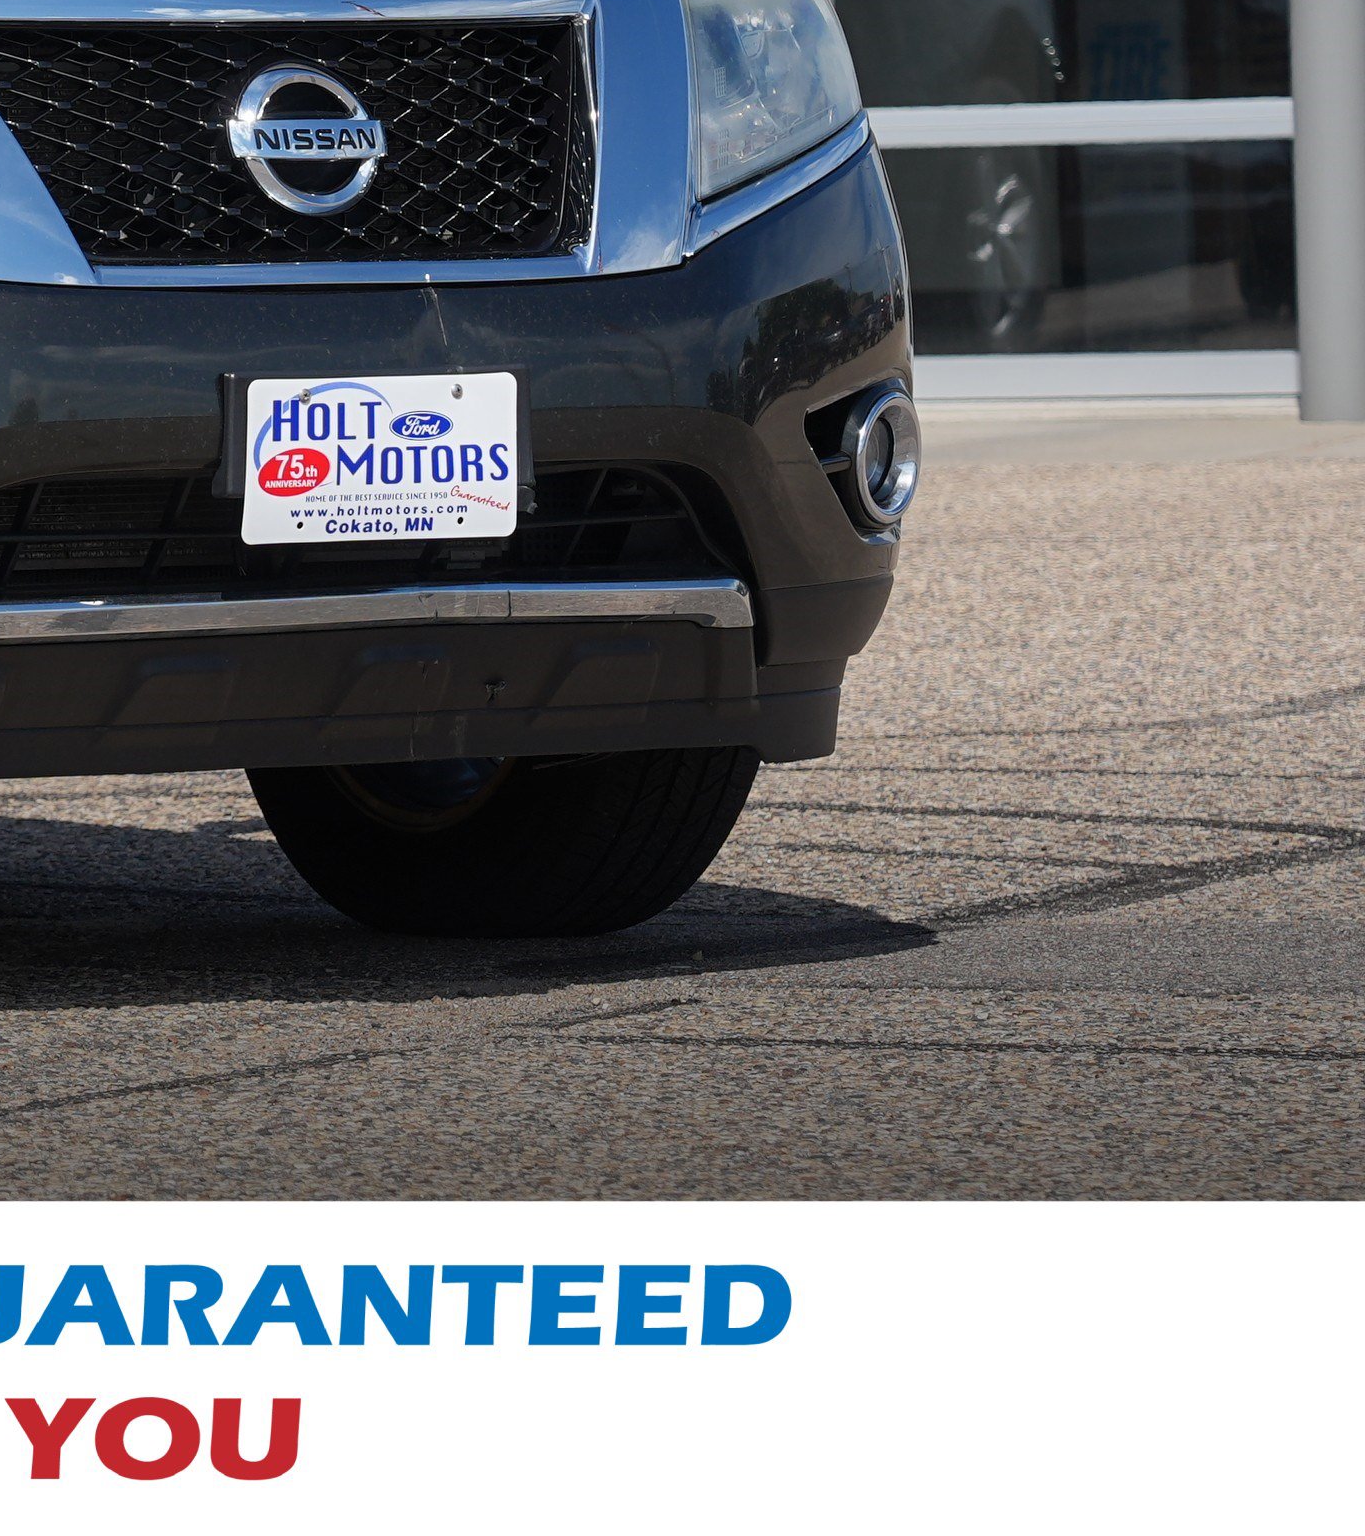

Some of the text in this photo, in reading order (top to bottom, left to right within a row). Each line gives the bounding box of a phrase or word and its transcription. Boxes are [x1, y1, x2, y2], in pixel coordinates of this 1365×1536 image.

[254, 127, 376, 151] NISSAN
[272, 399, 382, 442] HOLT
[401, 414, 440, 436] Ford
[275, 454, 318, 479] 75th
[336, 443, 509, 486] MOTORS
[265, 479, 317, 488] ANNIVERSARY
[355, 493, 371, 501] BEST
[405, 492, 427, 500] SINCE
[430, 491, 448, 499] 1950
[450, 485, 510, 511] Guaranteed
[291, 504, 468, 518] www.holtmotors.com
[325, 517, 434, 535] Cokato, MN
